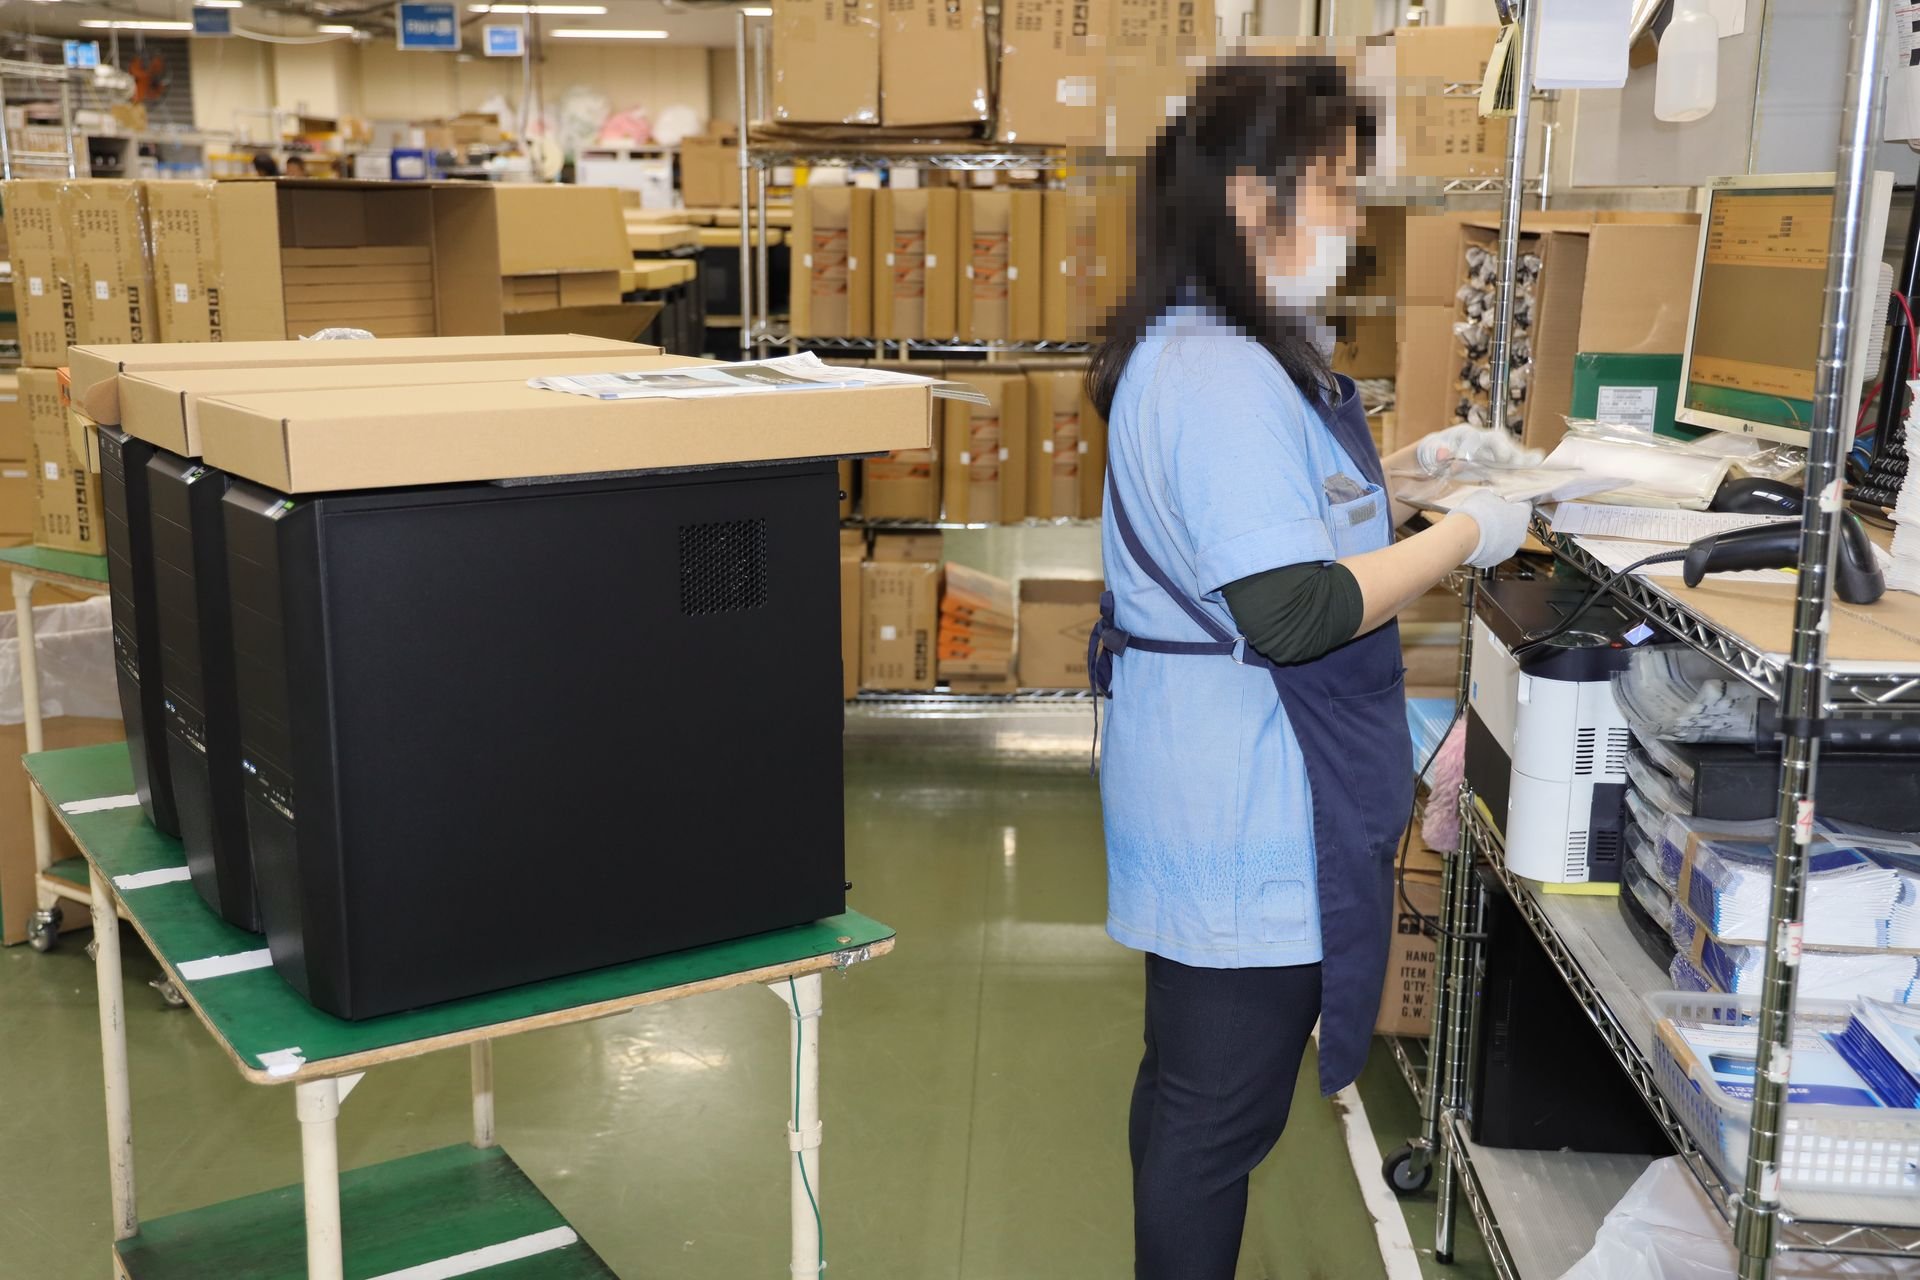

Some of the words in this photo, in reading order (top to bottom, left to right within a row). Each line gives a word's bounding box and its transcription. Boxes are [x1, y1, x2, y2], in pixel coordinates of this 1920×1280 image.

[1798, 811, 1814, 836] 4
[1791, 936, 1802, 957] 3
[1401, 966, 1426, 978] ITEM
[1403, 994, 1428, 1006] N.W.
[1402, 1006, 1426, 1019] G.W.
